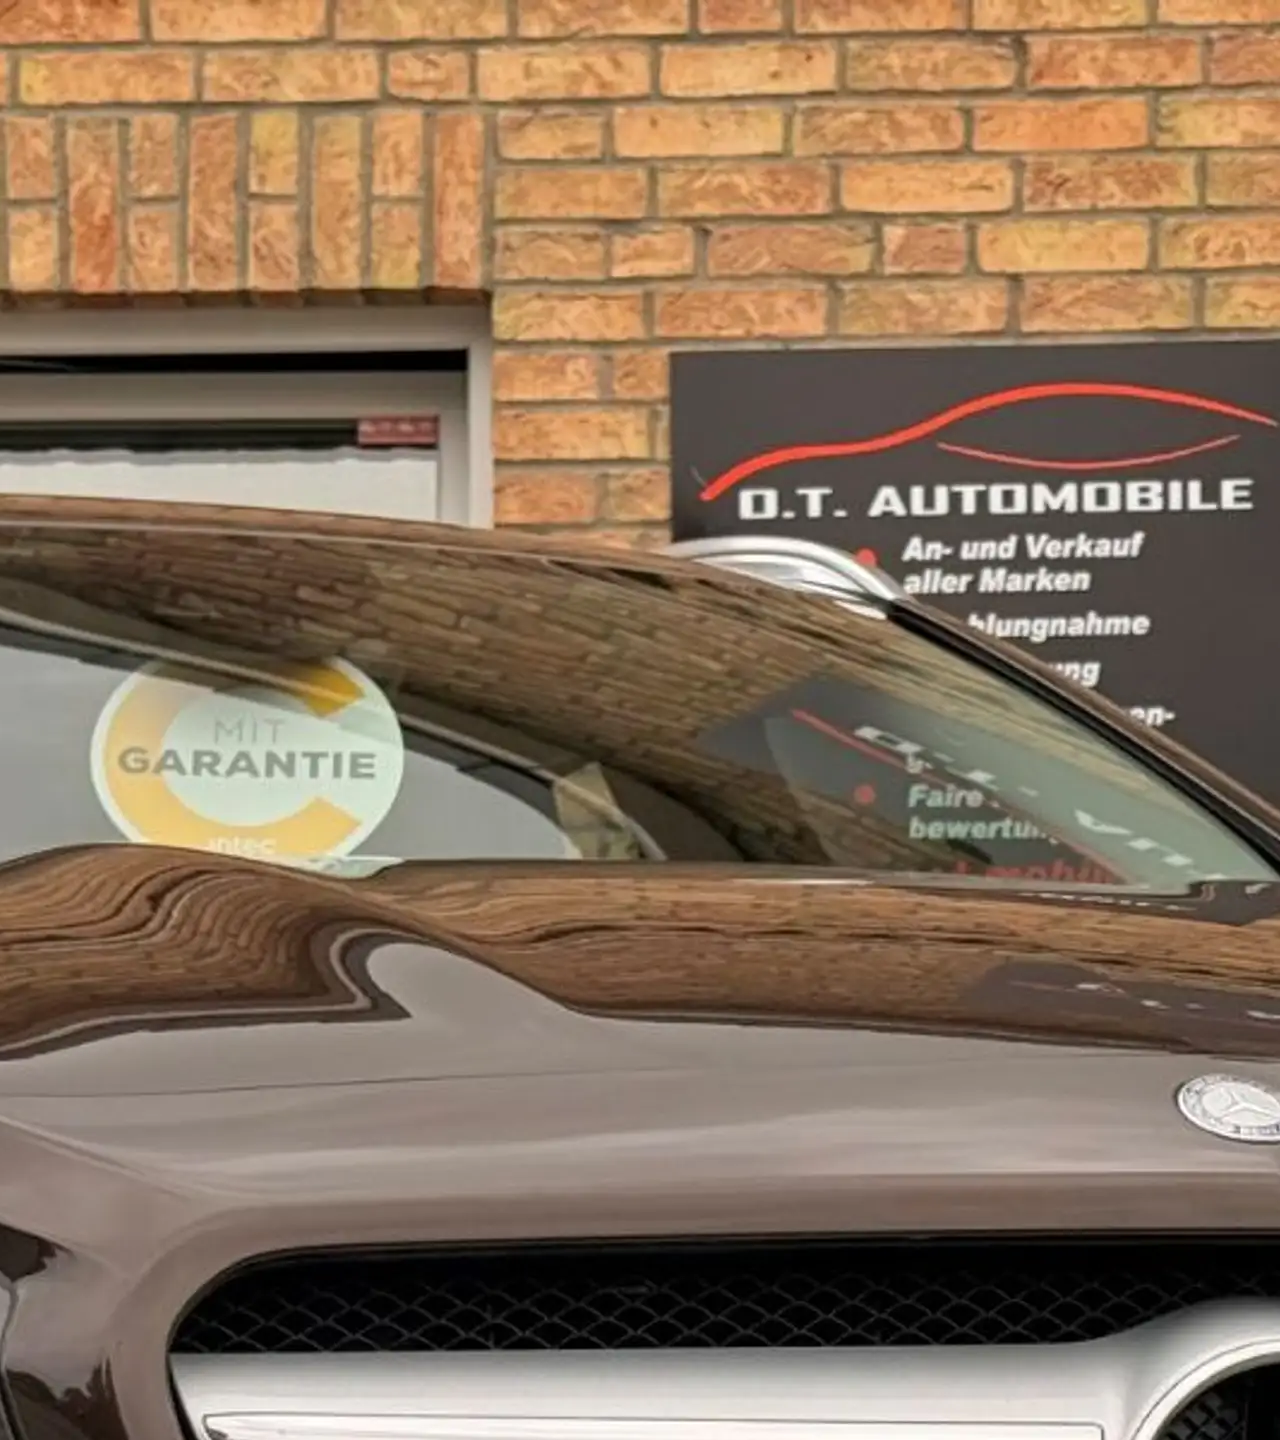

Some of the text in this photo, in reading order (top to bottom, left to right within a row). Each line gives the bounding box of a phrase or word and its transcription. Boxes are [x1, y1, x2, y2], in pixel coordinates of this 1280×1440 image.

[738, 478, 1254, 520] O.T. AUTOMOBILE
[901, 531, 1146, 562] An- und Verkauf
[903, 566, 1092, 594] aller Marken
[968, 611, 1151, 643] hlungnahme
[214, 716, 286, 745] MIT
[118, 745, 378, 780] GARANTIE
[908, 783, 984, 808] Faire
[908, 816, 1059, 846] bewertu
